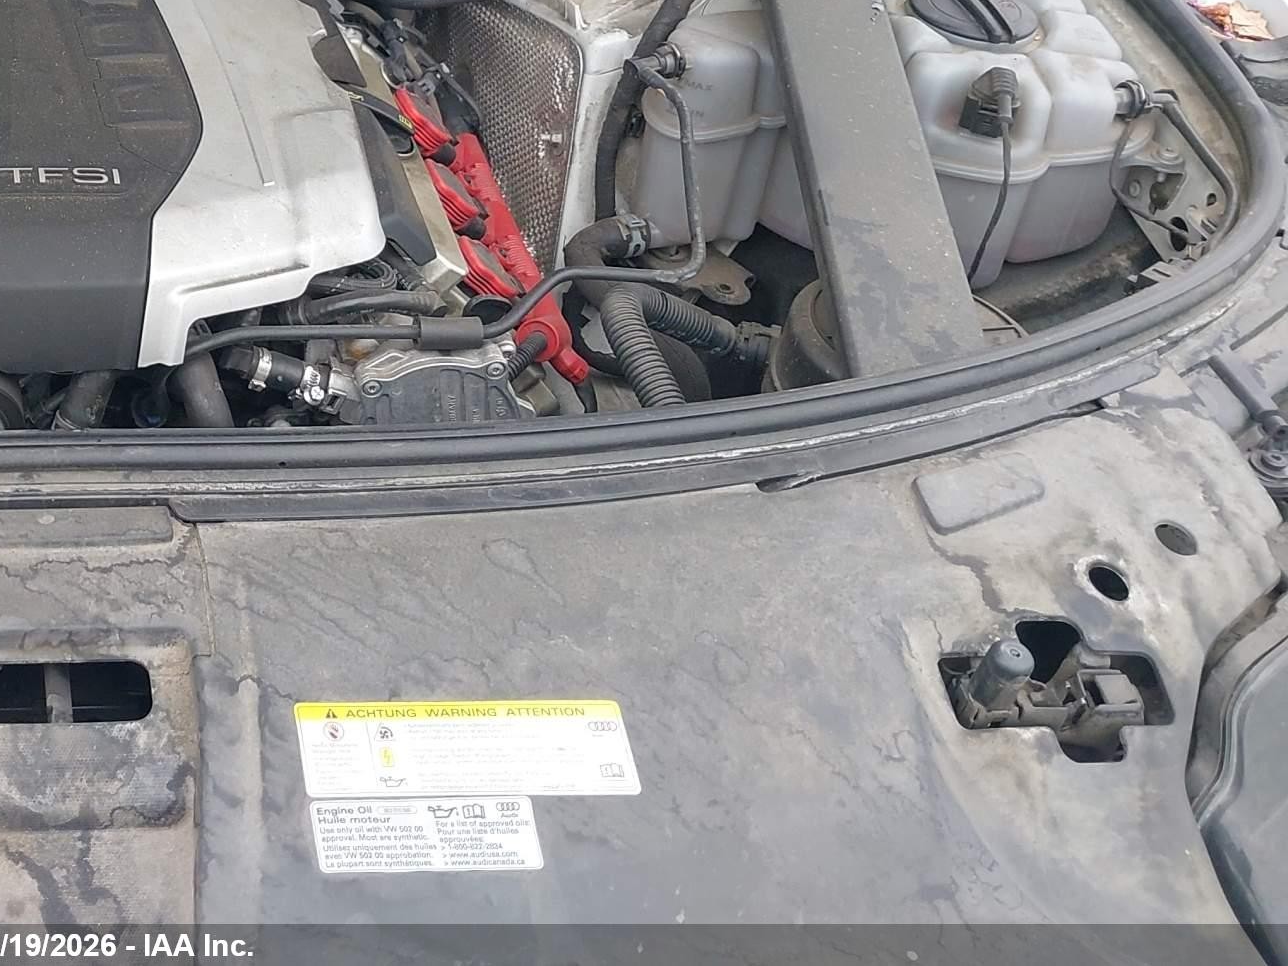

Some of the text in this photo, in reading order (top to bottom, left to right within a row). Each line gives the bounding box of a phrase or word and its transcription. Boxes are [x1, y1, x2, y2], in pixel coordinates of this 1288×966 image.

[0, 167, 121, 185] TFSI
[345, 707, 585, 718] ACHTUNG WARNING ATTENTION
[316, 805, 372, 816] Engine Oil
[479, 820, 514, 828] approved
[355, 825, 364, 833] oil
[366, 825, 383, 833] with
[353, 844, 397, 852] uniquement
